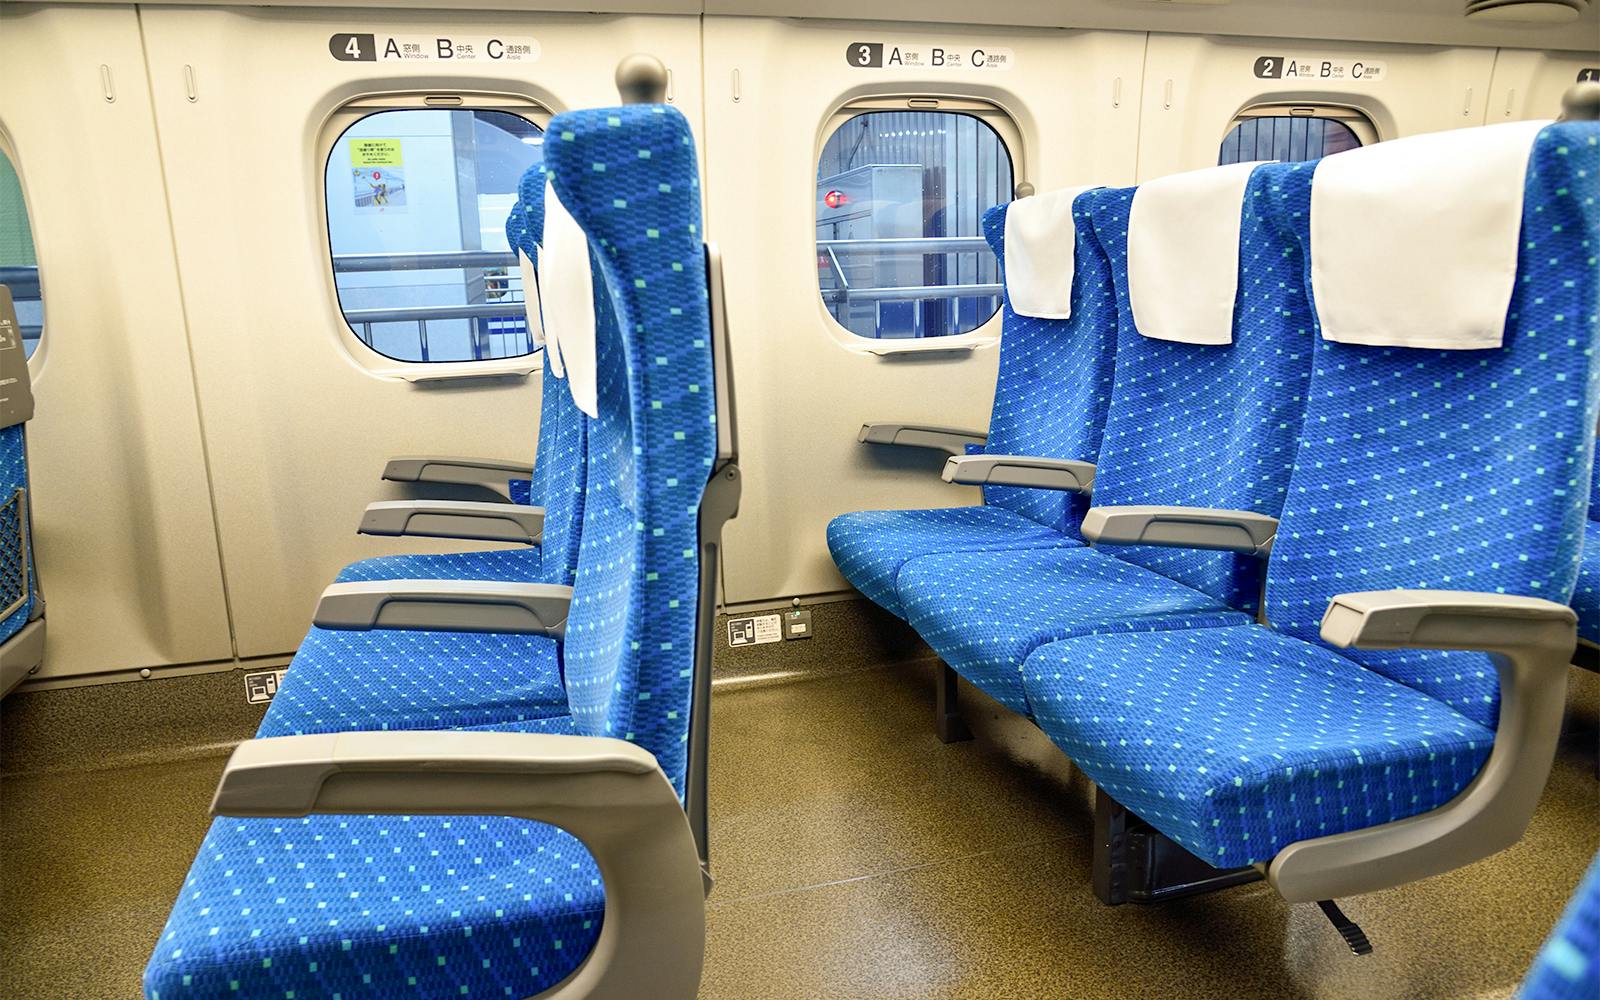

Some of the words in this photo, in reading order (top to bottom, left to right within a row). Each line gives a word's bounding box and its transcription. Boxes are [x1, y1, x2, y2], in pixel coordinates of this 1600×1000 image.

[345, 37, 361, 59] 4
[384, 38, 401, 58] A
[437, 38, 453, 59] B
[456, 45, 473, 53] 中央
[487, 39, 503, 59] C
[858, 45, 871, 65] 3
[889, 47, 902, 65] A
[932, 48, 944, 66] B
[972, 49, 985, 67] C
[1262, 59, 1274, 76] 2
[1286, 60, 1298, 76] A
[1320, 62, 1332, 77] B
[1352, 62, 1364, 78] C
